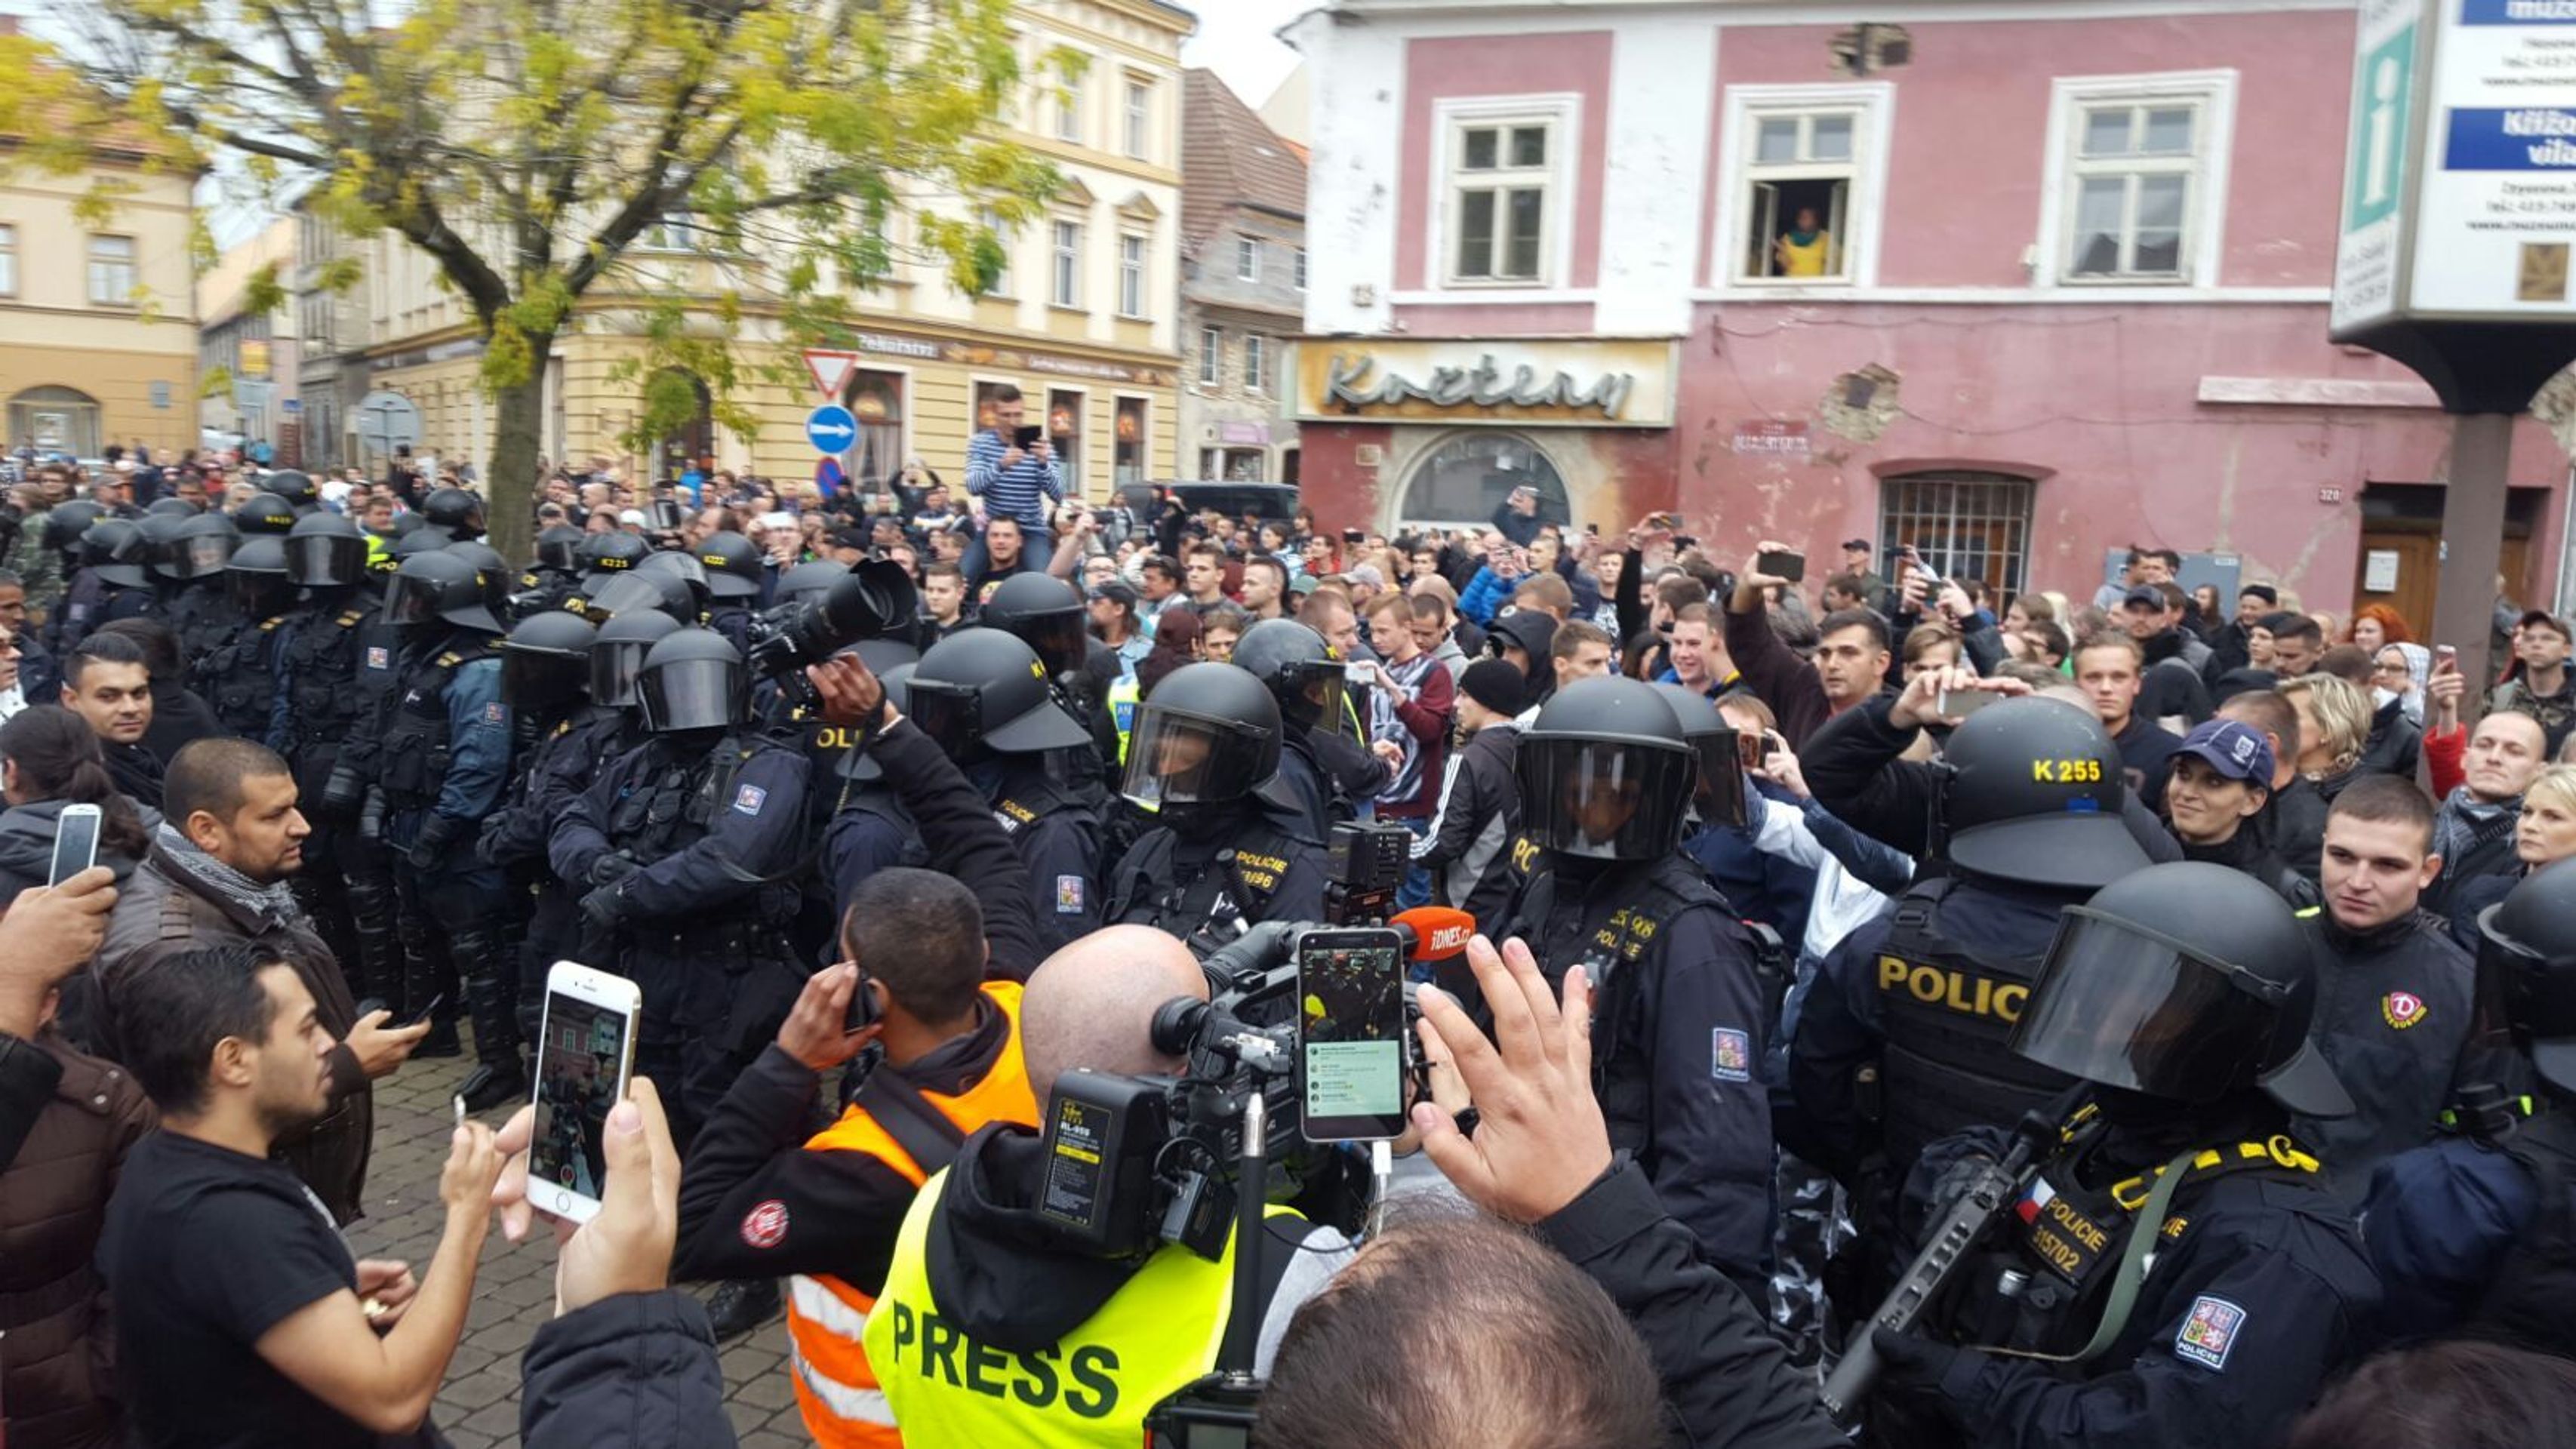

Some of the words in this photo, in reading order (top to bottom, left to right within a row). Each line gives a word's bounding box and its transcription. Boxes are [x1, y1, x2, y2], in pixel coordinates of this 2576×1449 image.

[1236, 851, 1288, 874] POLICIE
[2045, 1196, 2107, 1253] POLICIE
[893, 1298, 1120, 1419] PRESS
[2177, 1342, 2220, 1363] POLICIE
